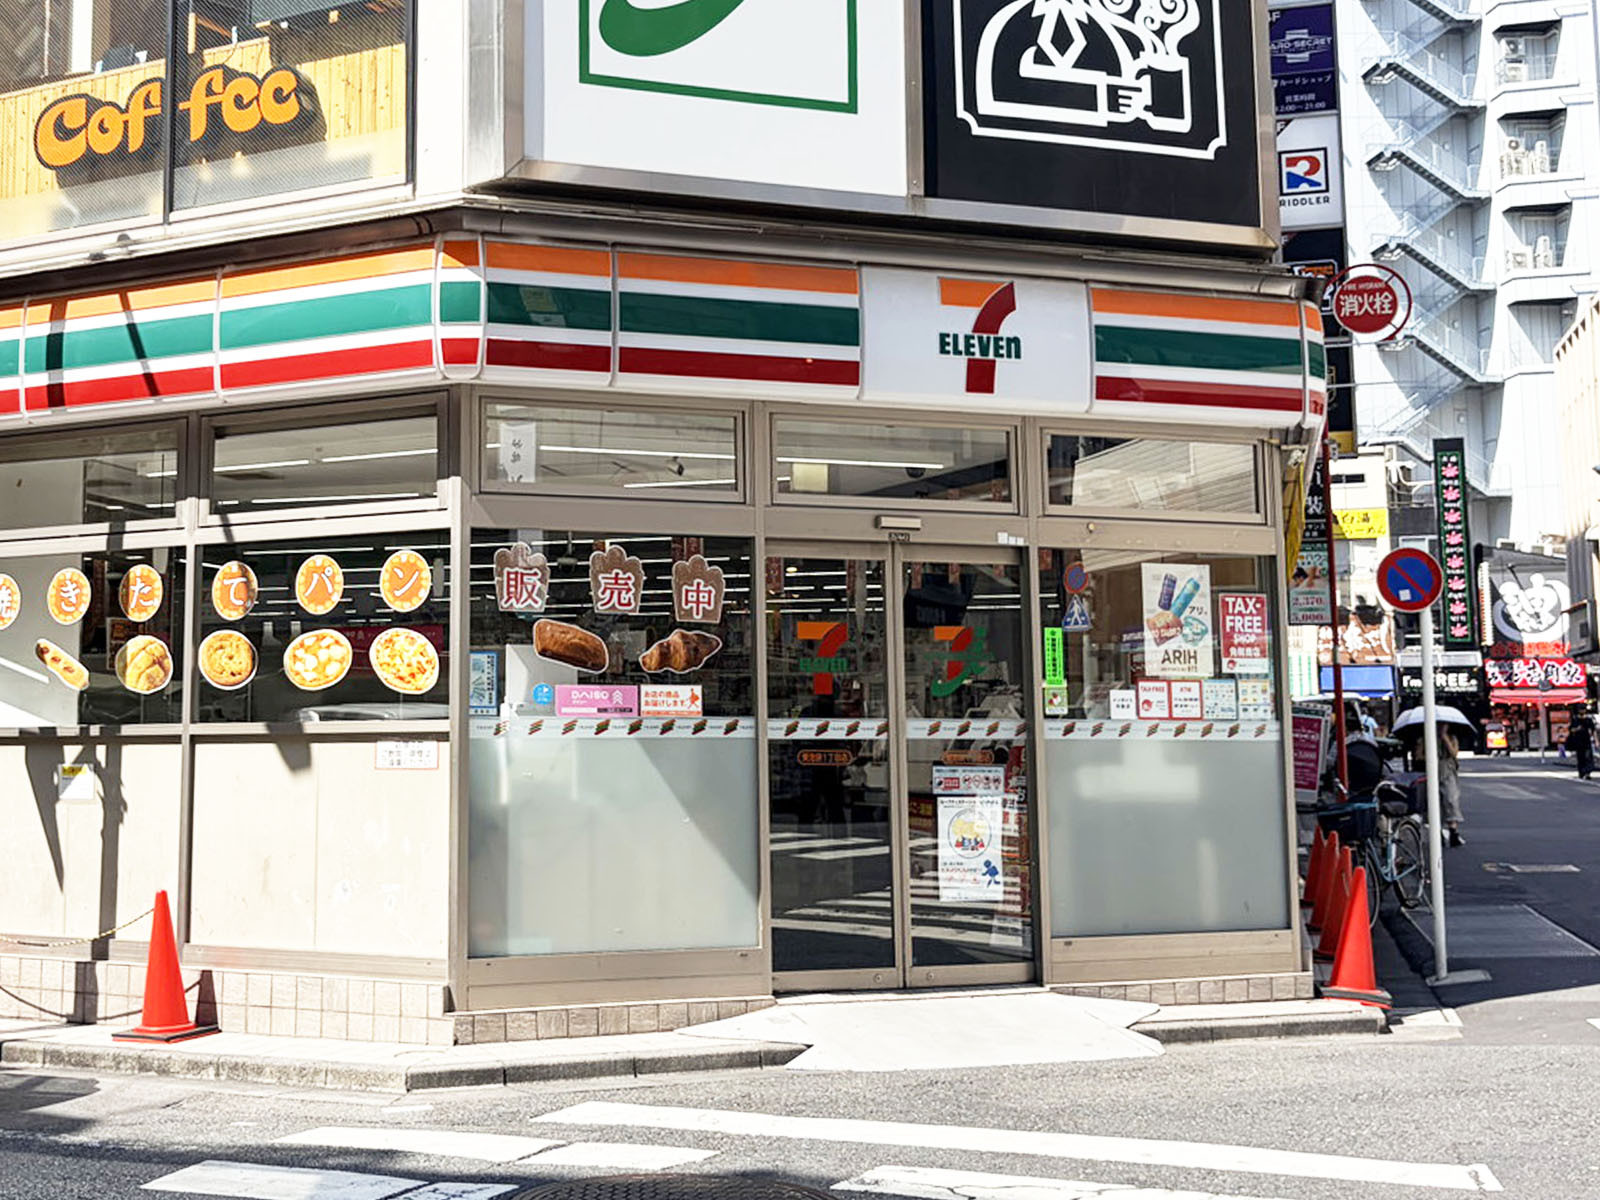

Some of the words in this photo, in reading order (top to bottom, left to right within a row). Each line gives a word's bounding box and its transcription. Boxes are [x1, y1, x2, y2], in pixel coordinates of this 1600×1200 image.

[1279, 196, 1330, 206] RIDDLER
[1339, 292, 1393, 317] 消火栓
[938, 276, 1017, 394] 7
[1225, 597, 1262, 614] TAX-
[1225, 616, 1262, 632] FREE
[1160, 649, 1198, 665] ARIH
[571, 690, 609, 700] DAISO
